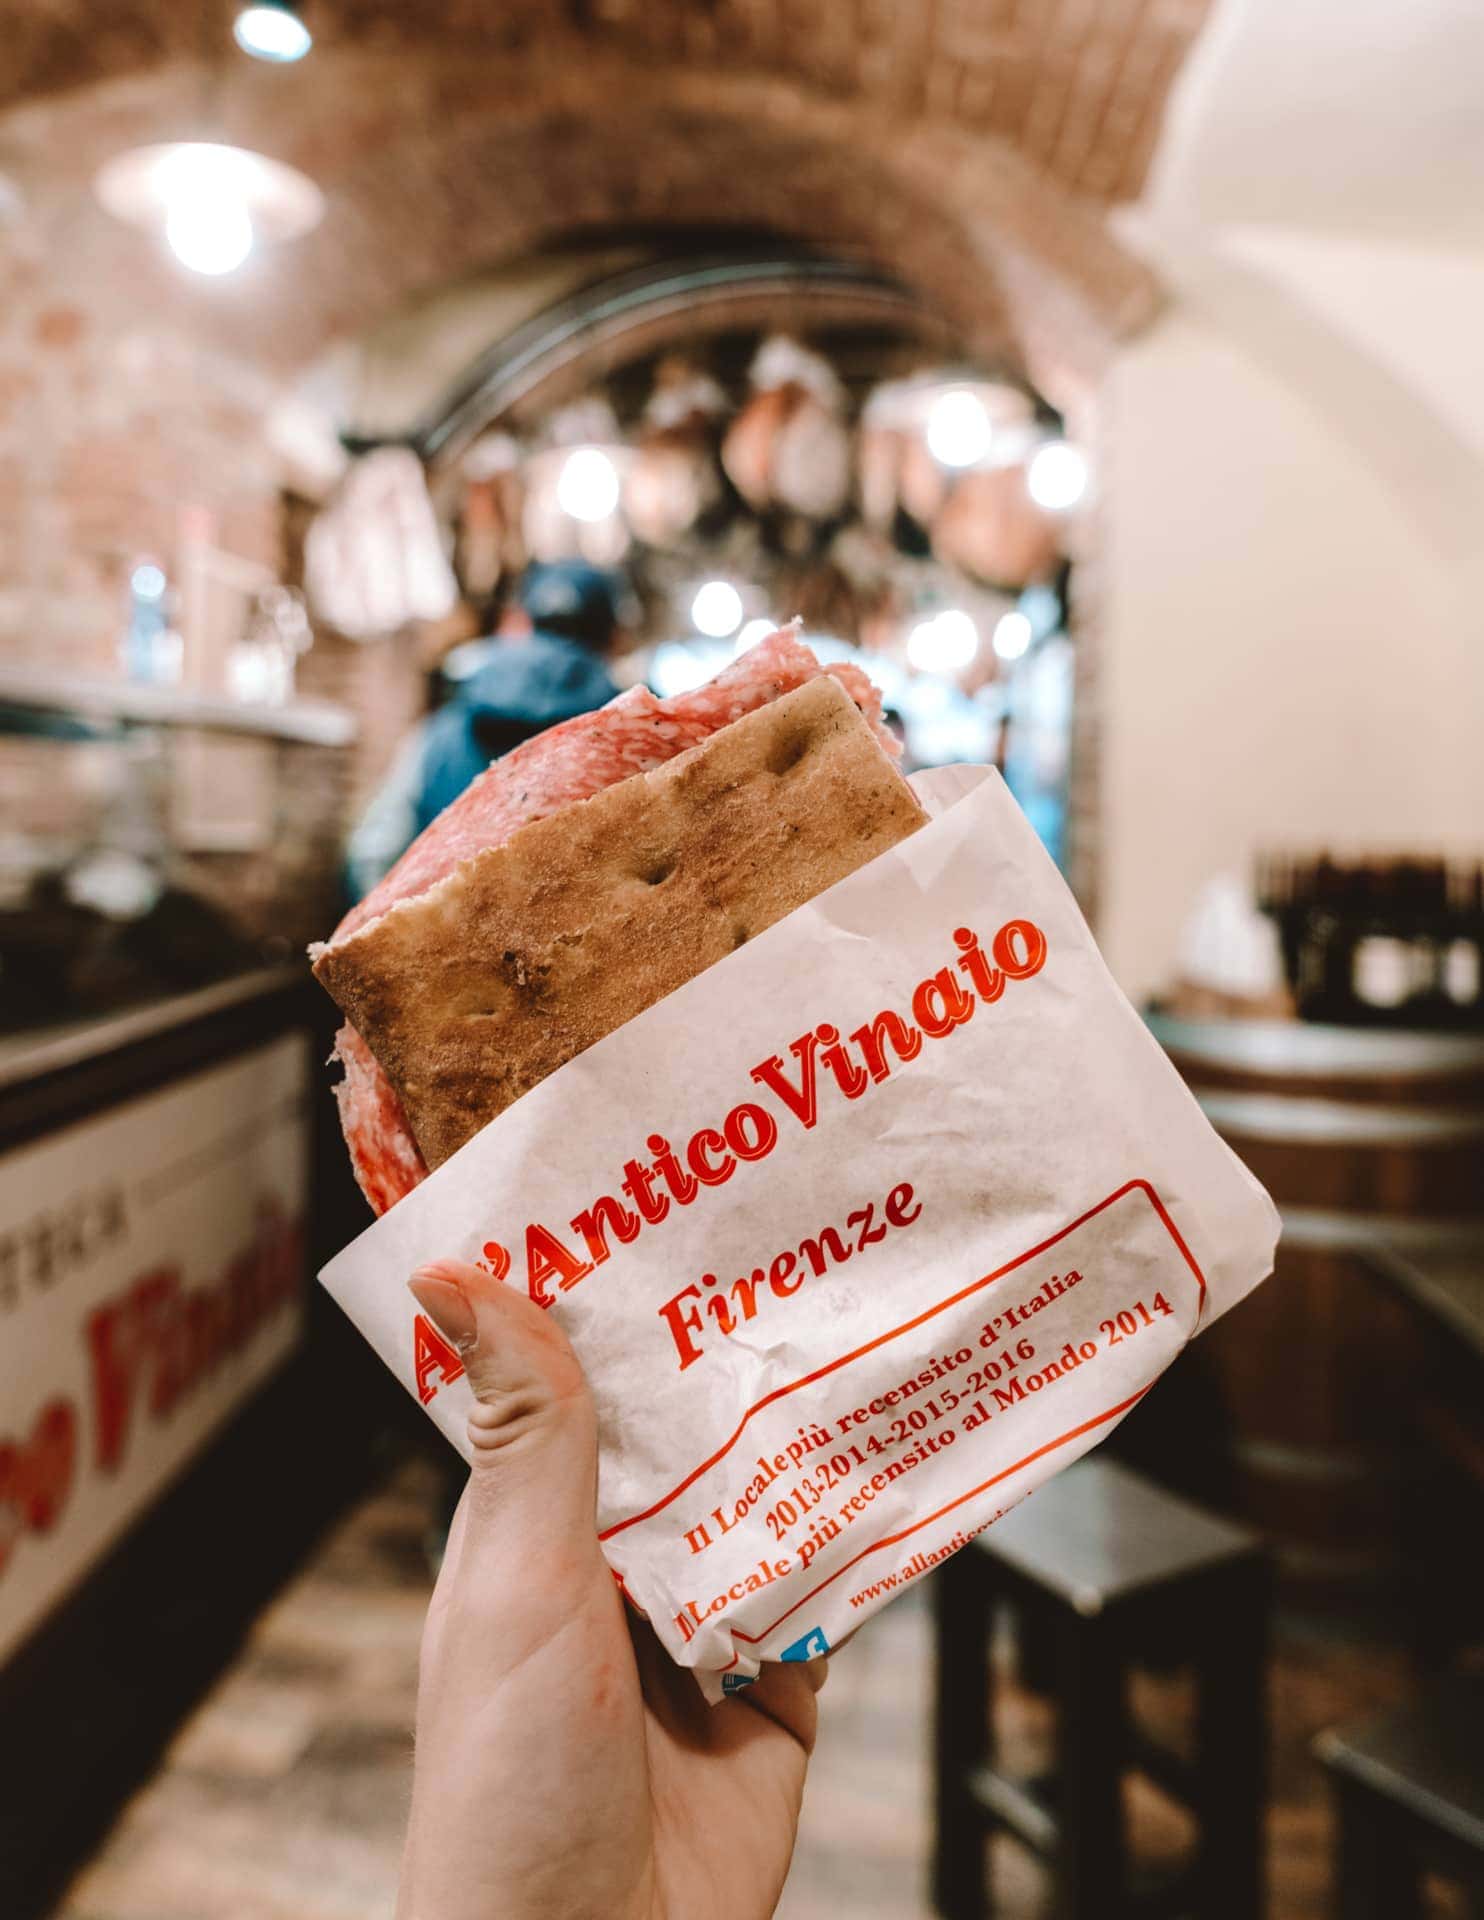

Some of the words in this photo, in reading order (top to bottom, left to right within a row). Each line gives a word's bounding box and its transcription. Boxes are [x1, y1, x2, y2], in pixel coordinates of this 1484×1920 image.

[658, 1182, 922, 1372] Firenze
[683, 1523, 714, 1554] Il
[711, 1454, 789, 1535] Locale
[785, 1424, 834, 1469] più
[836, 1348, 973, 1435] recensito
[979, 1268, 1084, 1349] d'Italia
[684, 1558, 793, 1626] Locale
[796, 1516, 843, 1571] più
[839, 1427, 956, 1524] recensito
[961, 1400, 993, 1432] al
[989, 1339, 1098, 1412] Mondo
[1099, 1291, 1175, 1347] 2014
[766, 1338, 1036, 1542] 2013-2014-2015-2016
